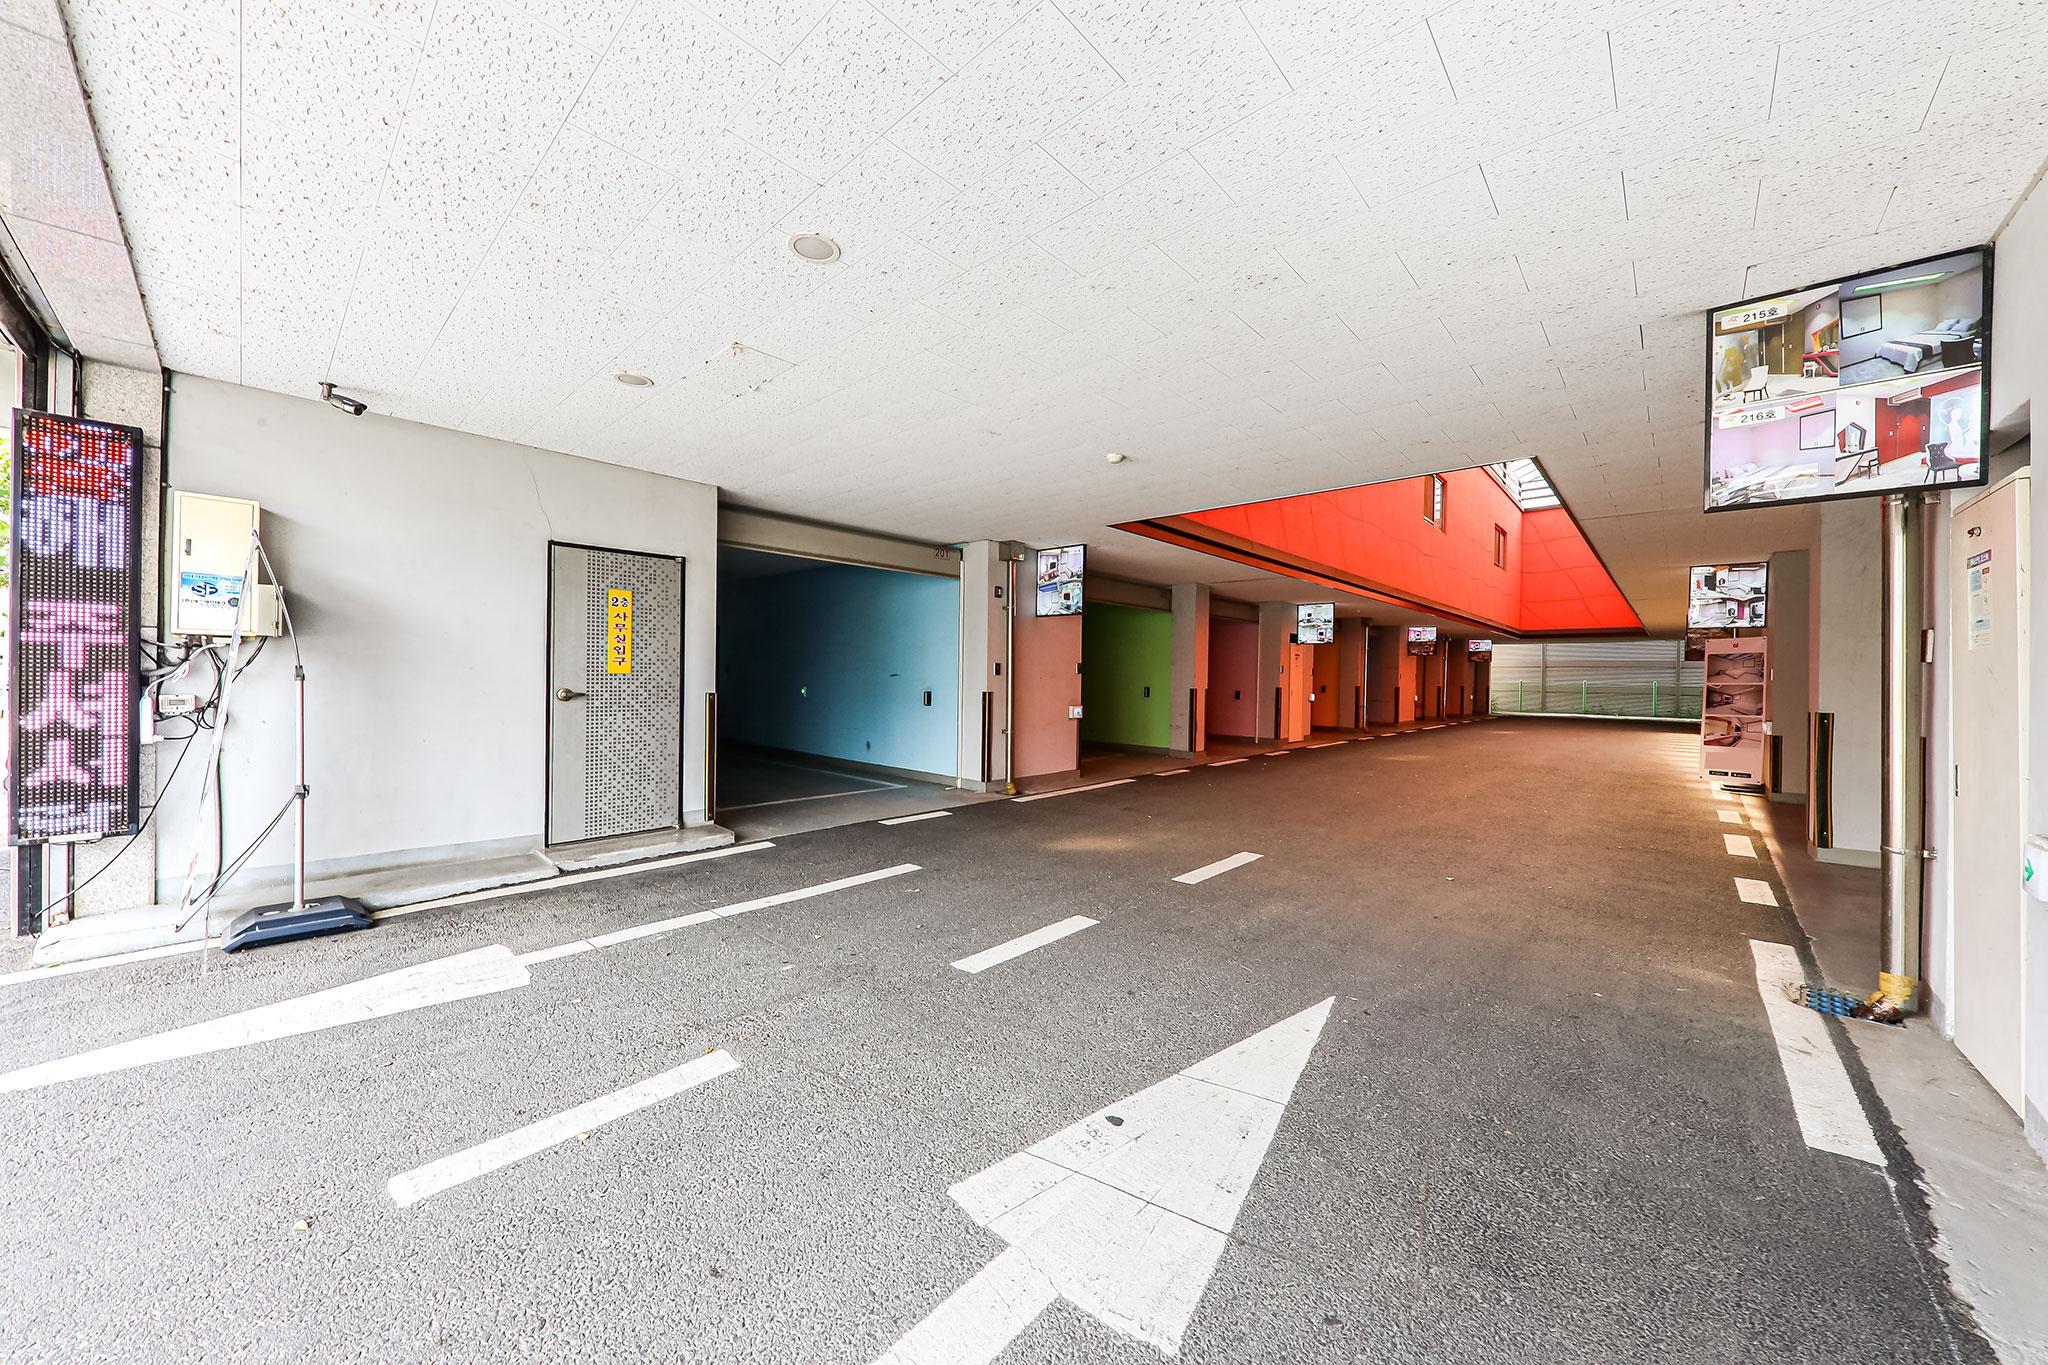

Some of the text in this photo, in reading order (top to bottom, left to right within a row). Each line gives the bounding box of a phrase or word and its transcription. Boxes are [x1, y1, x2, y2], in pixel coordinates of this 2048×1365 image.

[1743, 306, 1779, 323] 215호
[1740, 409, 1776, 424] 216호
[935, 547, 949, 558] 201
[611, 596, 629, 608] 2층
